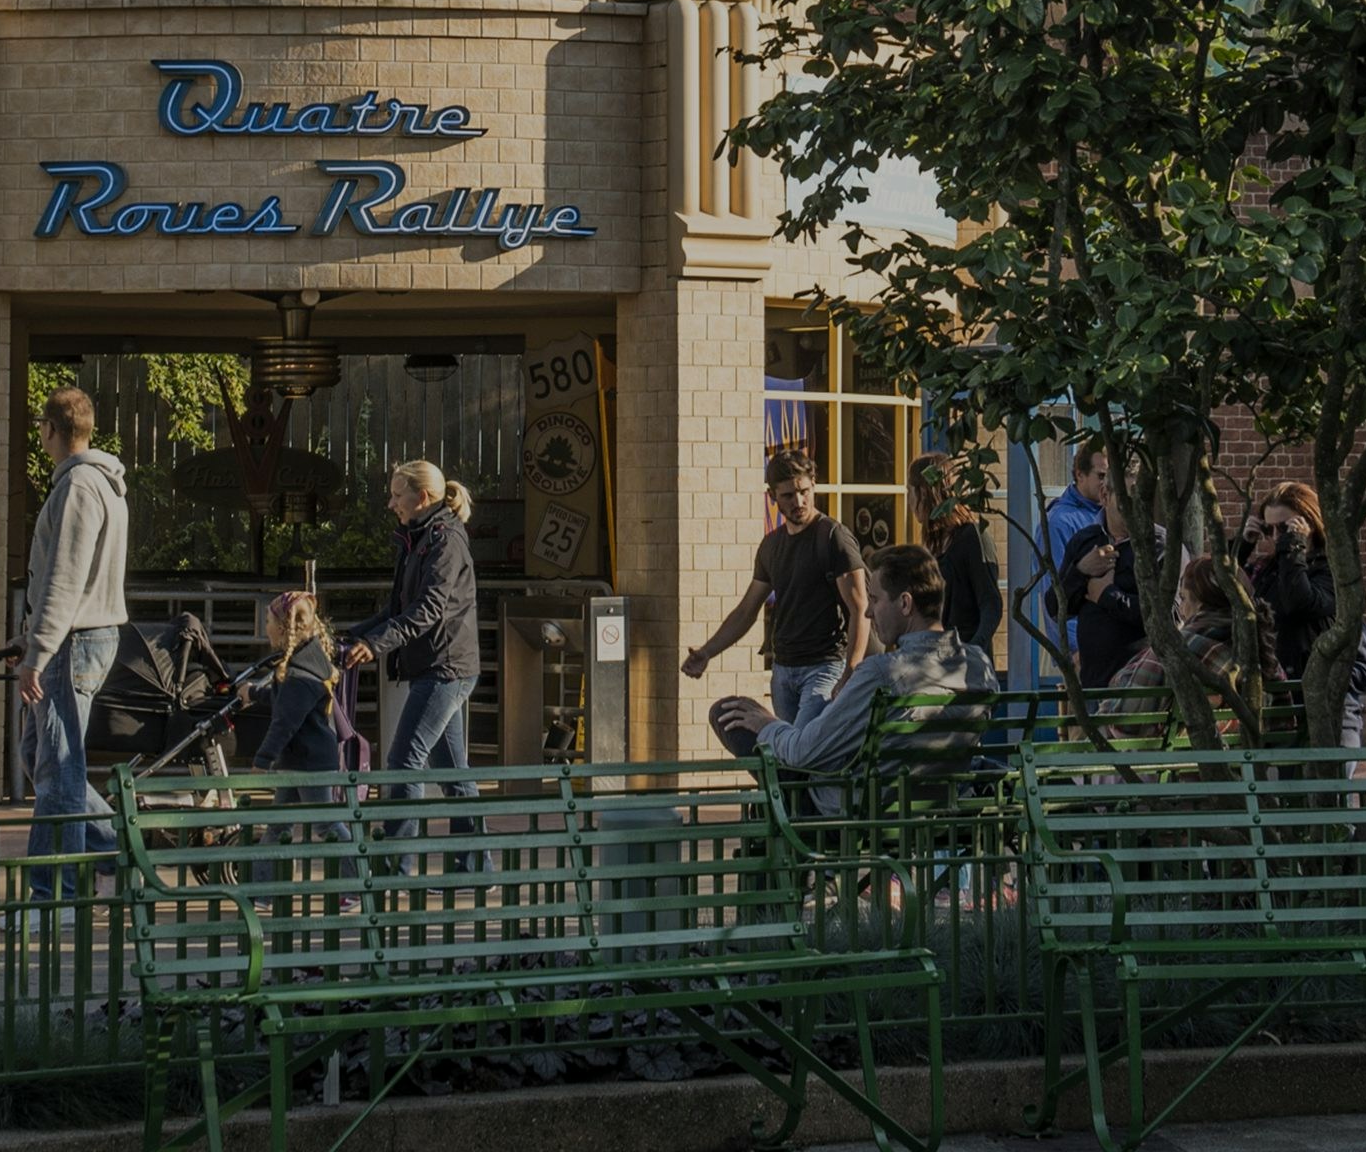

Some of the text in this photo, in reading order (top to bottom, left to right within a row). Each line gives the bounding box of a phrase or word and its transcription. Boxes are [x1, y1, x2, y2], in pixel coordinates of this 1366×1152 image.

[151, 59, 489, 138] Quatre
[35, 160, 598, 250] Roues Rallye
[529, 349, 594, 399] 580
[536, 415, 591, 446] DINOCO
[523, 450, 588, 493] GASOLINE
[542, 520, 575, 553] 25
[549, 505, 585, 528] SPEED LIMIT
